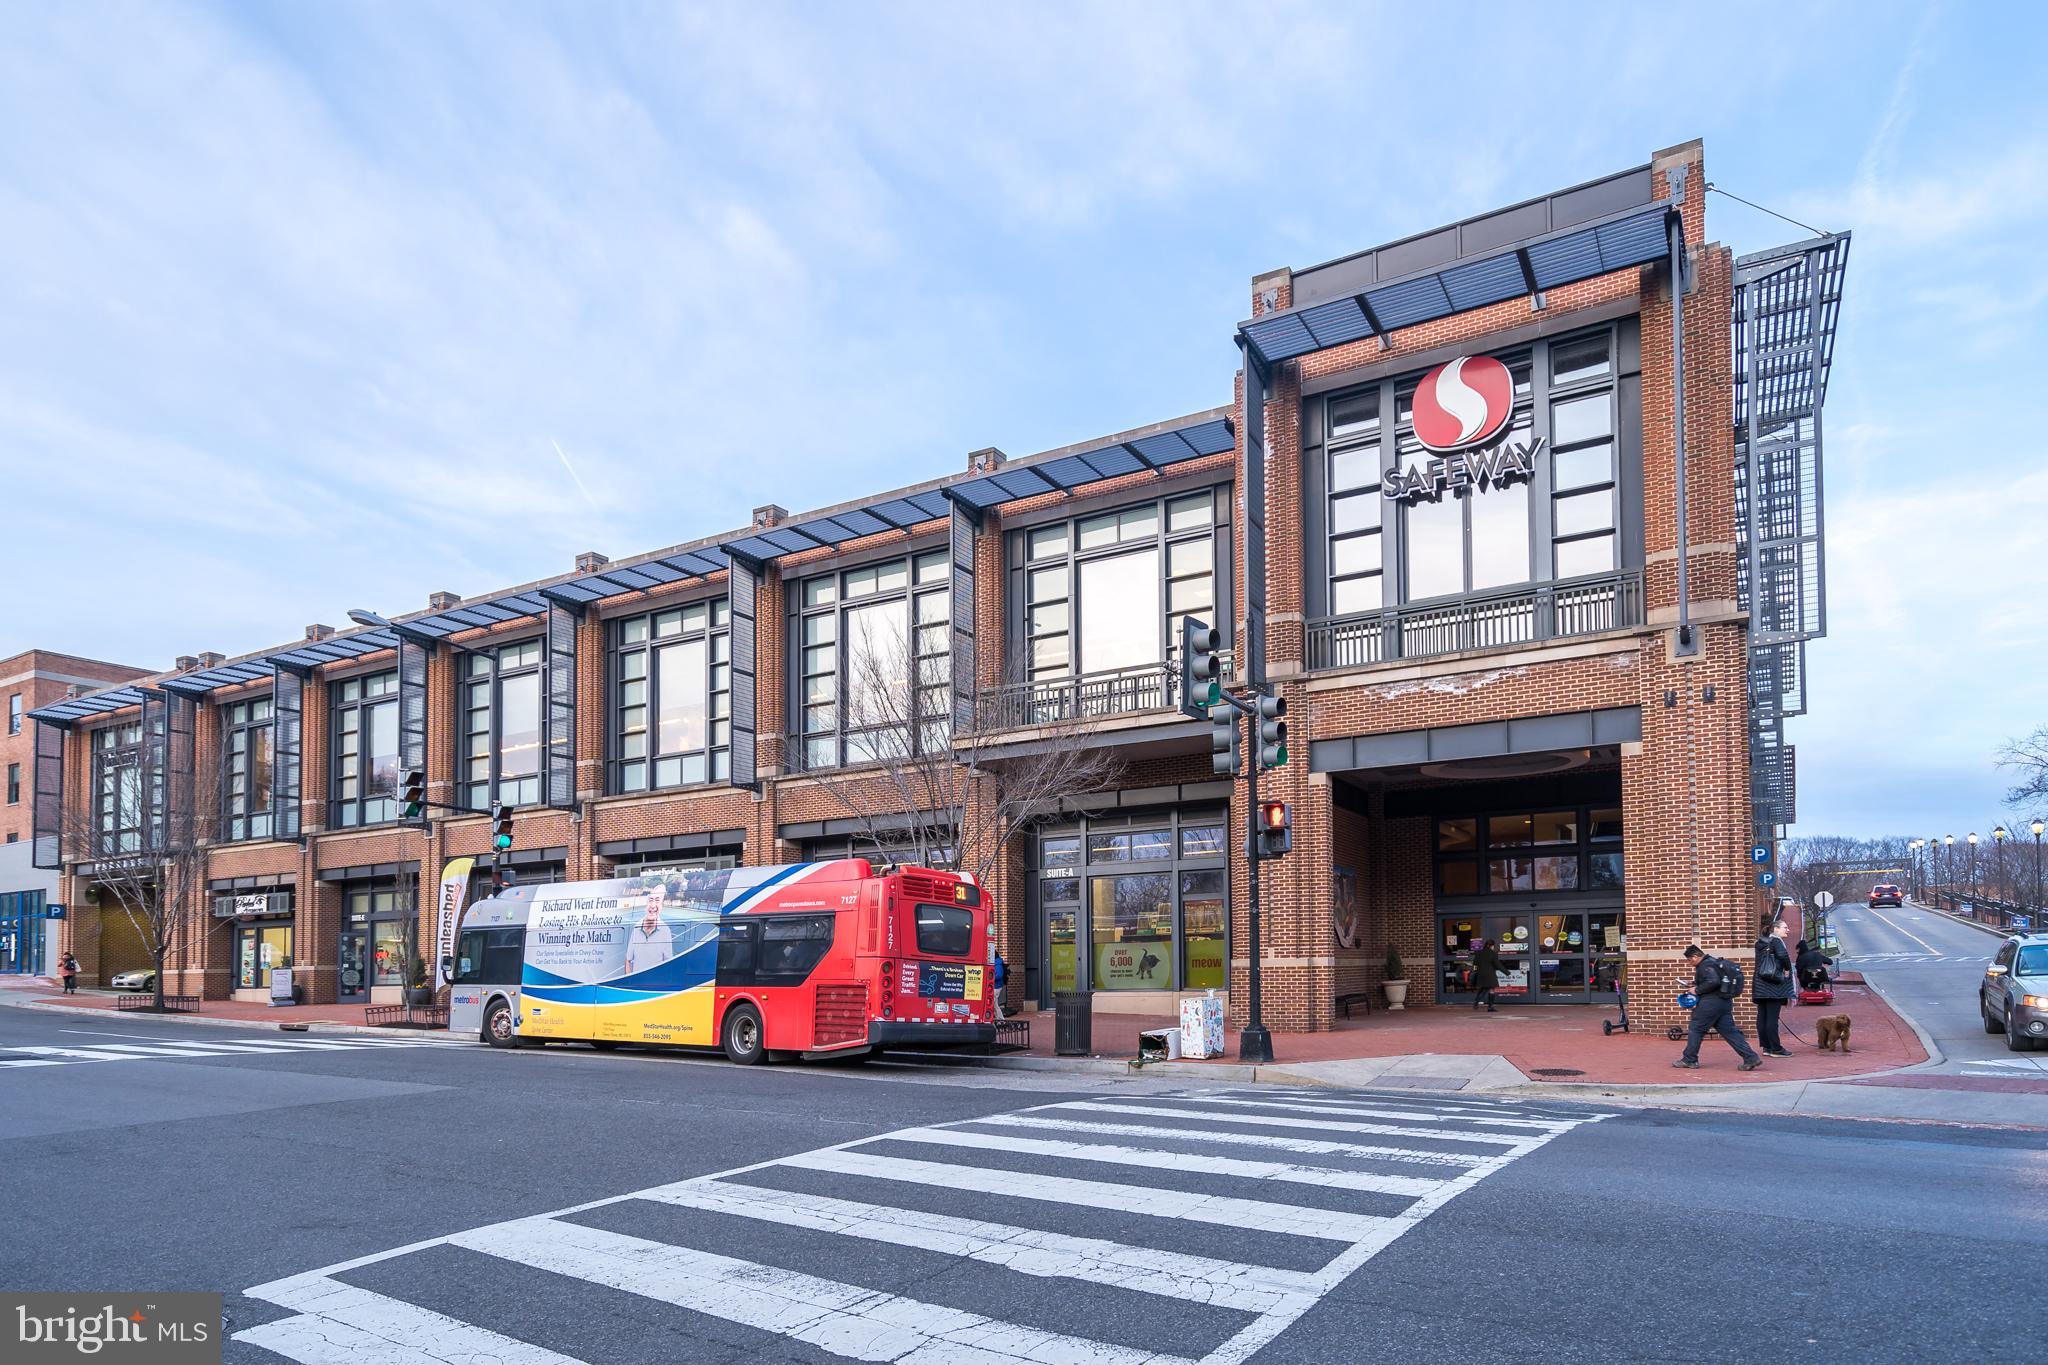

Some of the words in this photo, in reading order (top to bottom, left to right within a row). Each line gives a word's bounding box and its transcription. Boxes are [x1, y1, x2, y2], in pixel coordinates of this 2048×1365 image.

[1384, 437, 1546, 500] SAFEWAY
[1754, 848, 1766, 861] P
[1046, 868, 1074, 878] SUITE-A
[1763, 874, 1773, 884] P
[955, 886, 967, 900] 31
[542, 899, 572, 912] Richard
[572, 899, 595, 910] Went
[595, 897, 618, 909] From
[841, 895, 858, 905] 7127
[51, 907, 61, 917] P
[538, 916, 564, 930] Losing
[565, 915, 580, 927] His
[580, 914, 613, 926] Balance
[614, 915, 623, 925] to
[538, 932, 571, 947] Winning
[572, 931, 585, 944] the
[586, 930, 612, 943] Match
[1110, 956, 1133, 968] 6,000
[1191, 957, 1222, 969] meow
[901, 969, 914, 977] Every
[454, 996, 479, 1004] metrobus
